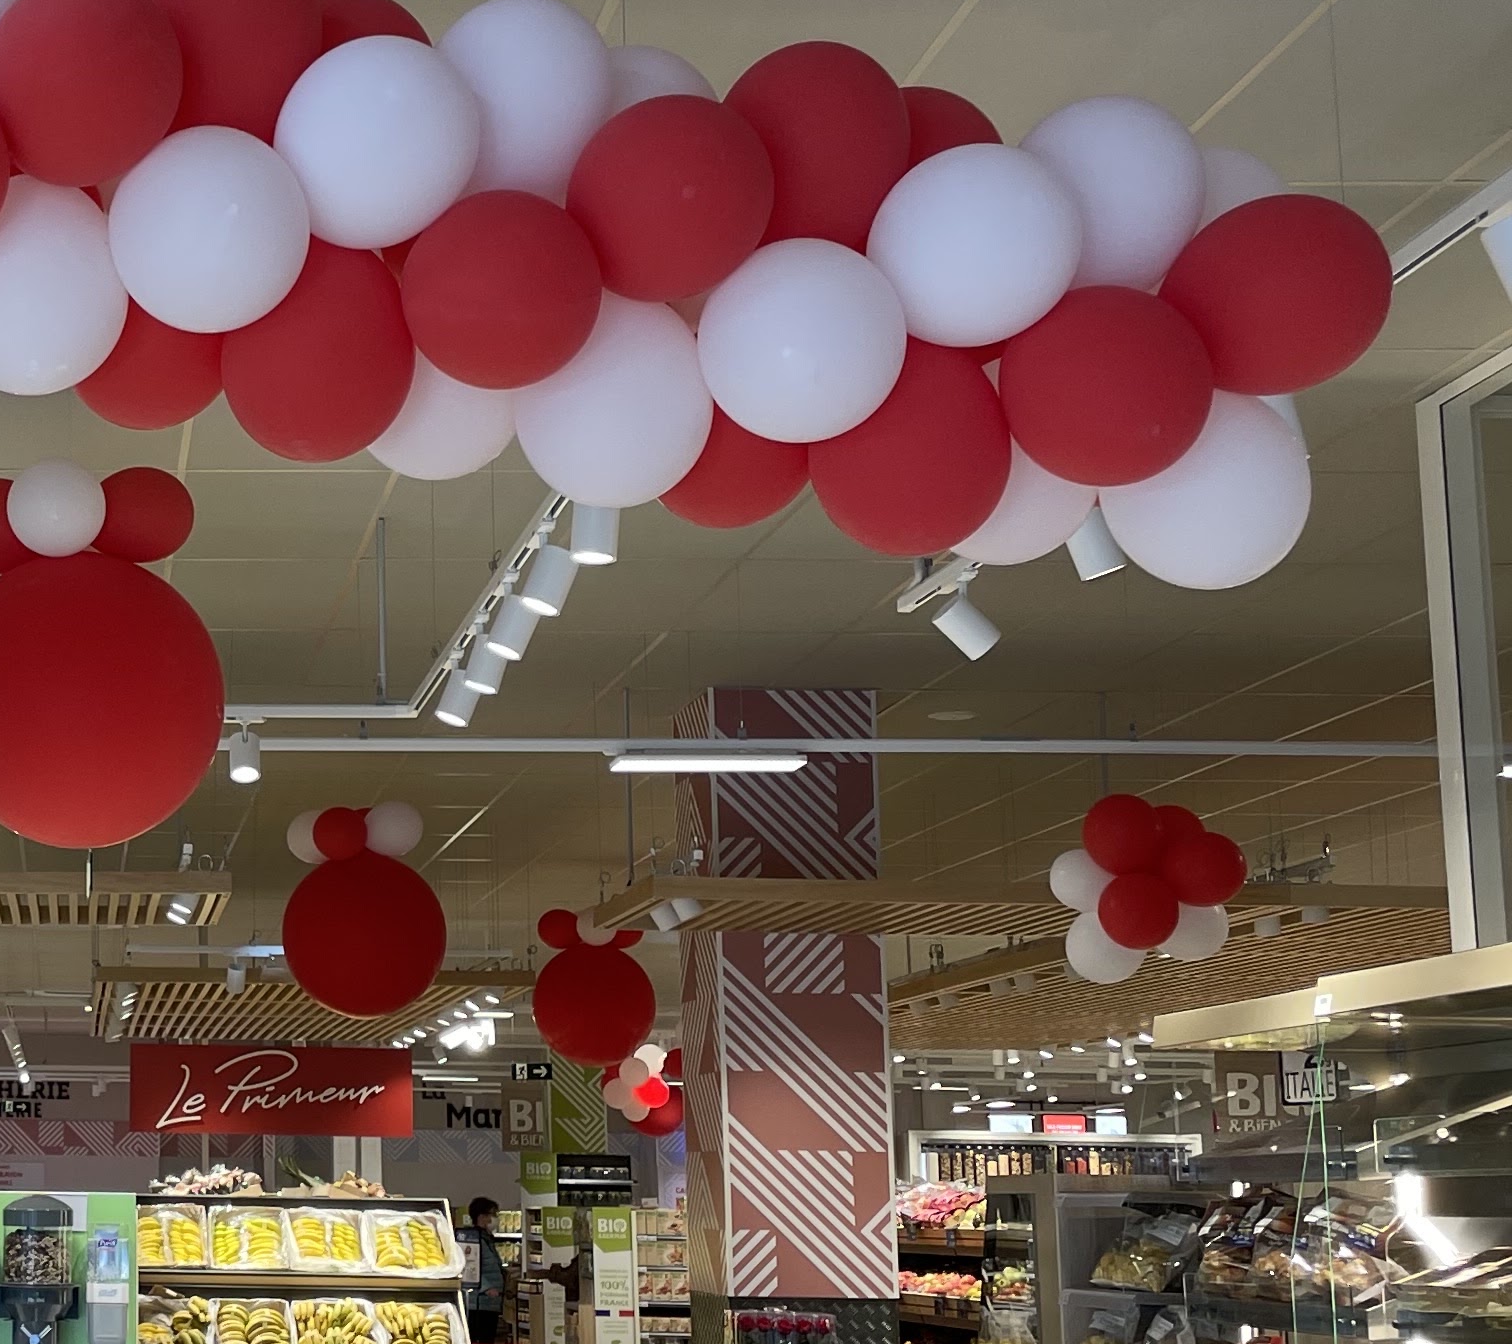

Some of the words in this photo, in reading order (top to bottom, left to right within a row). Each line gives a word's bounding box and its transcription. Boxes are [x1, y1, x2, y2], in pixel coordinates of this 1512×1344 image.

[156, 1064, 206, 1129] Le
[214, 1049, 386, 1114] Primeur
[526, 1161, 552, 1175] BIO
[546, 1216, 573, 1231] BIO
[597, 1218, 628, 1233] BIO
